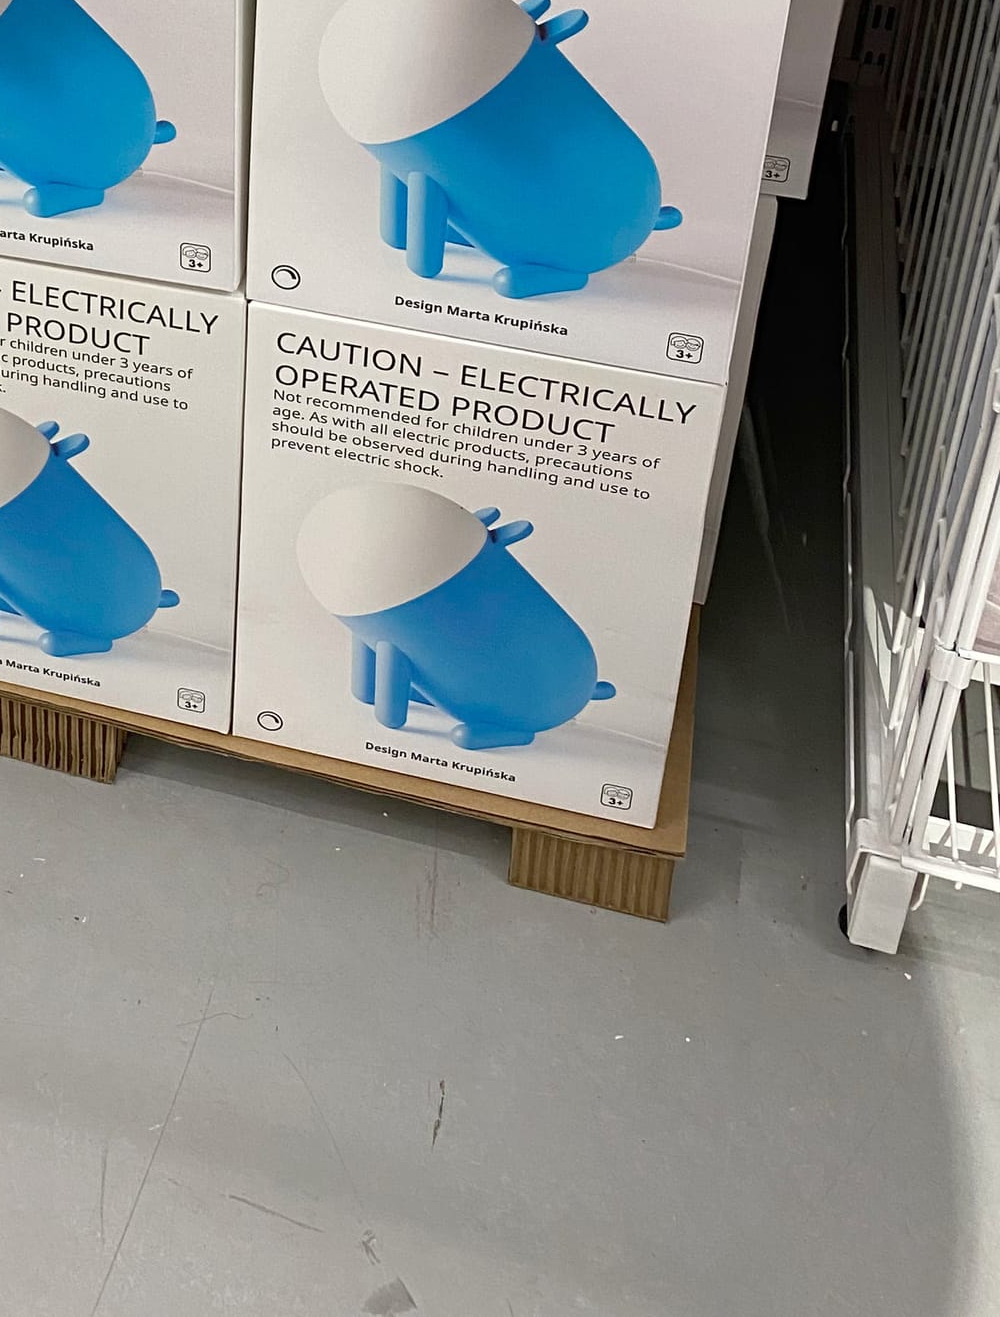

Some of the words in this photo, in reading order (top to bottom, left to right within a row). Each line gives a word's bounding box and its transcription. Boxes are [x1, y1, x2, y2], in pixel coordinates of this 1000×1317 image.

[765, 170, 780, 179] 3+
[29, 232, 94, 251] Krupińska
[187, 257, 204, 268] 3+
[12, 279, 219, 335] ELECTRICALLY
[394, 295, 442, 314] Design
[446, 304, 490, 322] Marta
[494, 313, 568, 336] Krupińska
[7, 311, 150, 356] PRODUCT
[674, 347, 695, 360] 3+
[43, 373, 106, 399] handling
[110, 389, 138, 402] and
[143, 394, 169, 407] use
[172, 398, 188, 410] to
[277, 332, 422, 377] CAUTION
[460, 364, 697, 424] ELECTRICALLY
[275, 364, 440, 412] OPERATED
[451, 395, 616, 443] PRODUCT
[5, 659, 40, 673] Marta
[365, 741, 407, 758] Design
[410, 751, 448, 767] Marta
